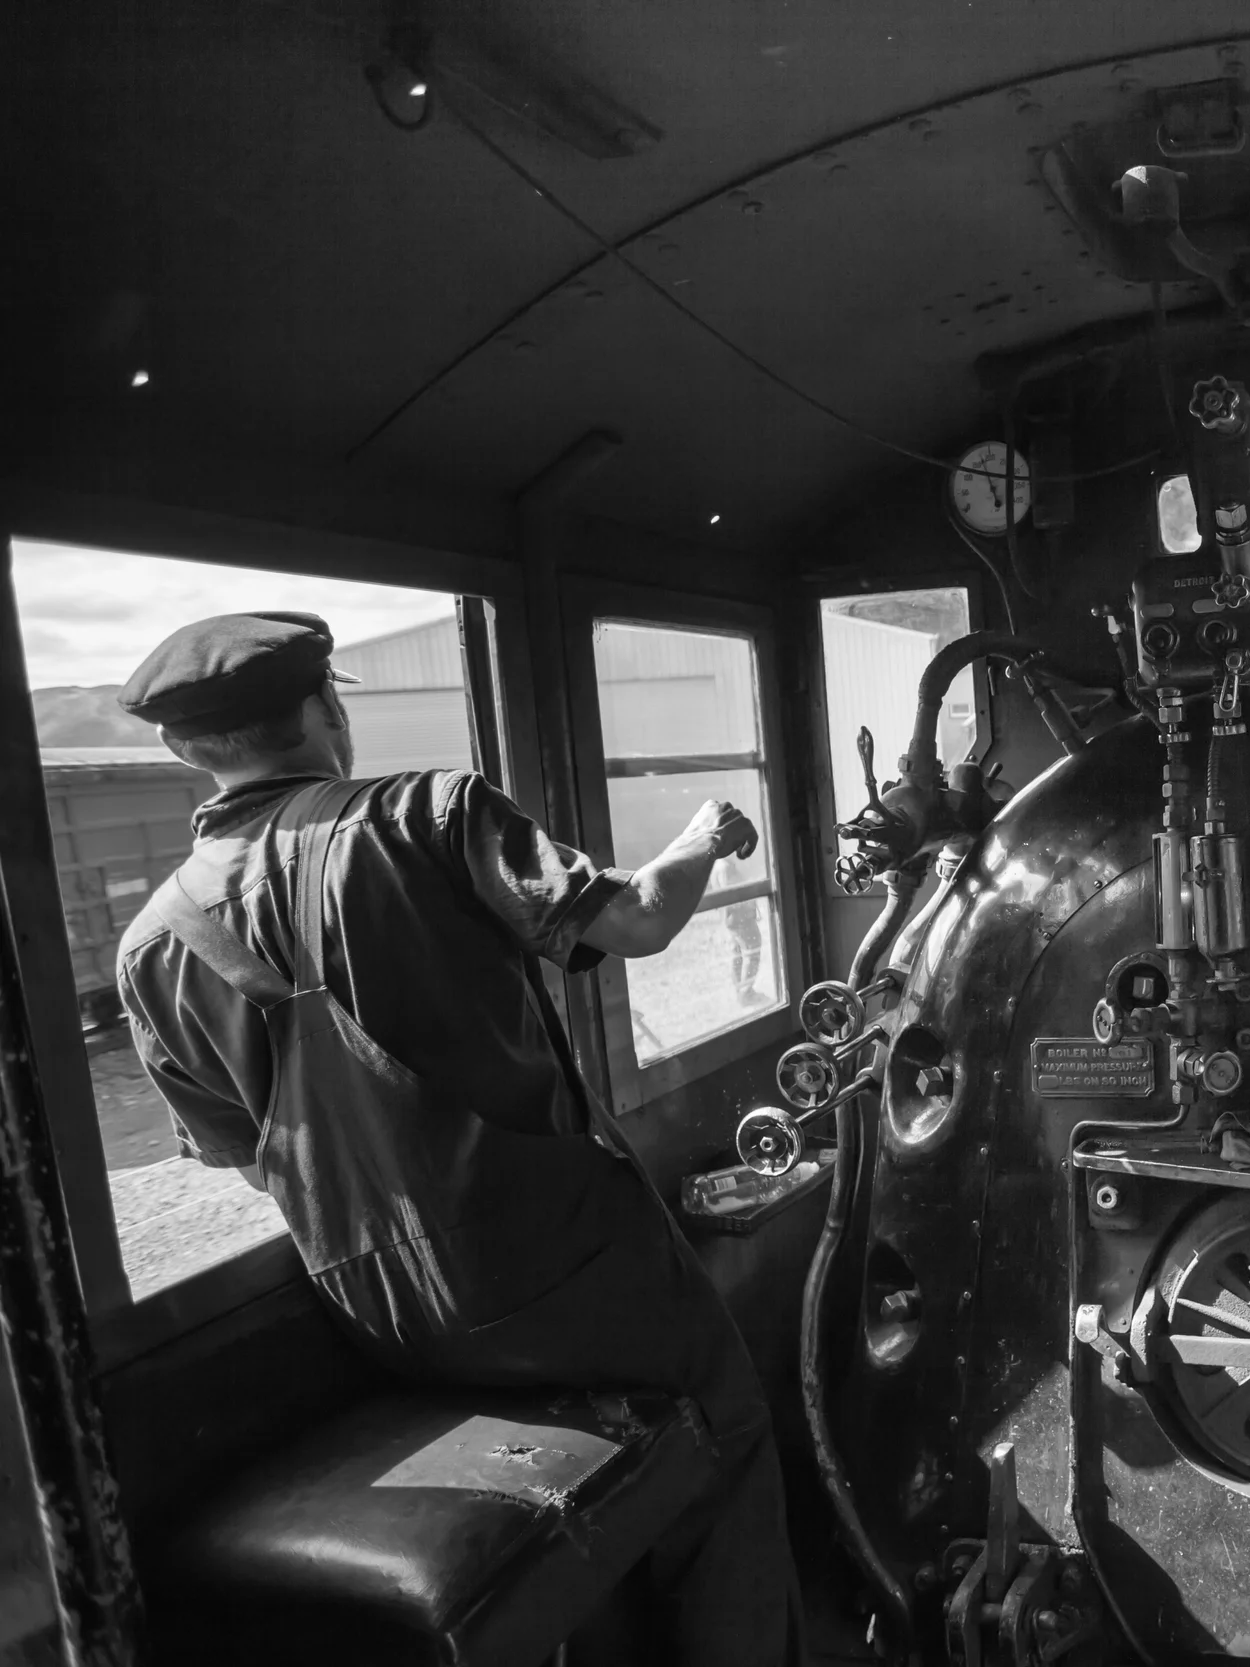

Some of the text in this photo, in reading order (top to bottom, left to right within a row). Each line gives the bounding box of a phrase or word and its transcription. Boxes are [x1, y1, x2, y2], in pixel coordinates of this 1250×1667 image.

[1173, 575, 1215, 588] DETROIT
[1047, 1048, 1088, 1058] BOILER
[1041, 1062, 1088, 1072] MAXIMUM
[1083, 1076, 1098, 1086] ON
[1120, 1076, 1146, 1086] INCH
